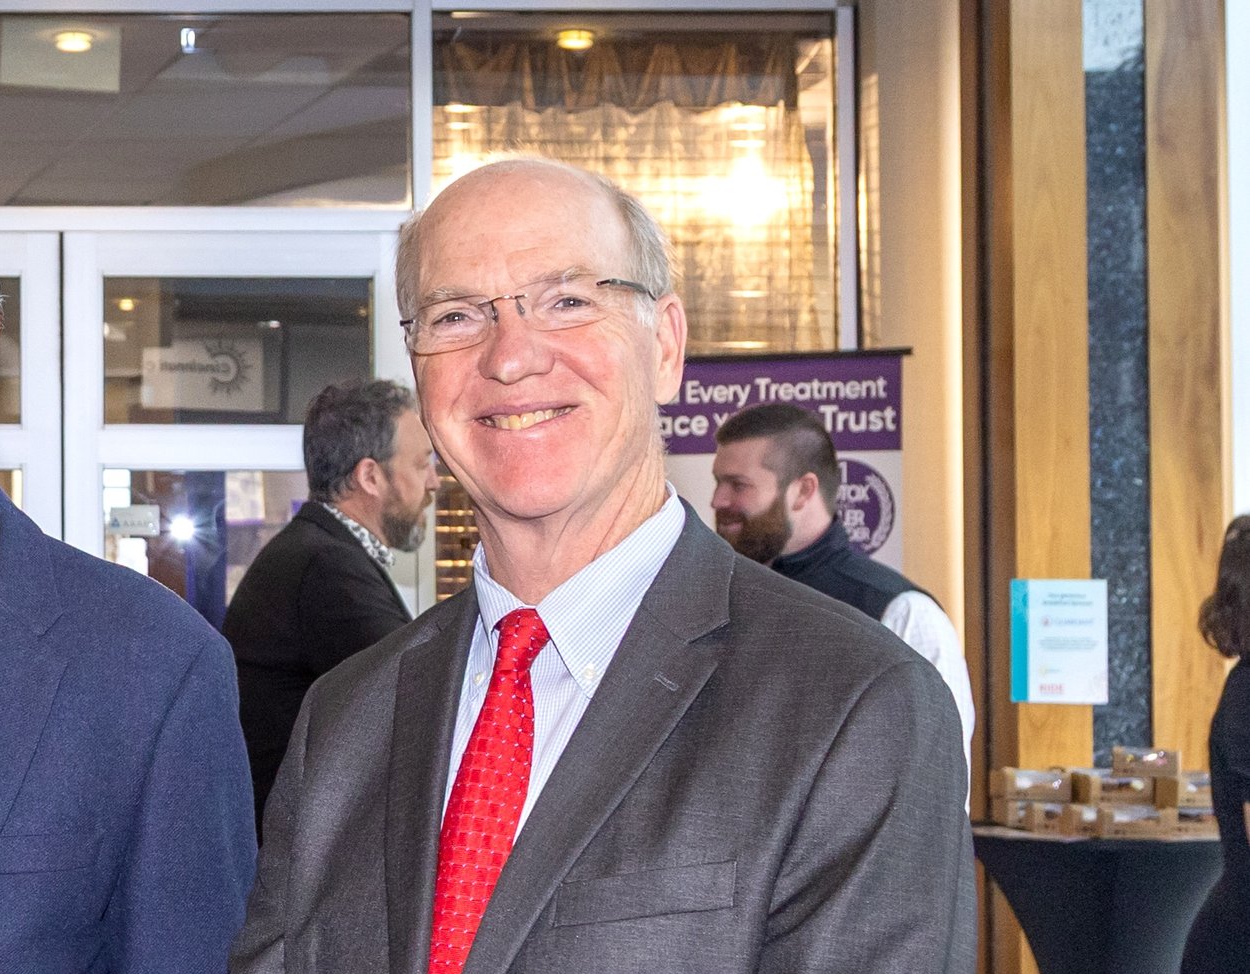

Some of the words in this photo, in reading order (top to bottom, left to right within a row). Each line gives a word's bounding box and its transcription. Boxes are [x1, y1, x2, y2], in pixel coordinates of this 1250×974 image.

[685, 380, 751, 408] Every
[754, 376, 888, 402] Treatment
[659, 415, 710, 437] ace
[818, 404, 897, 432] Trust
